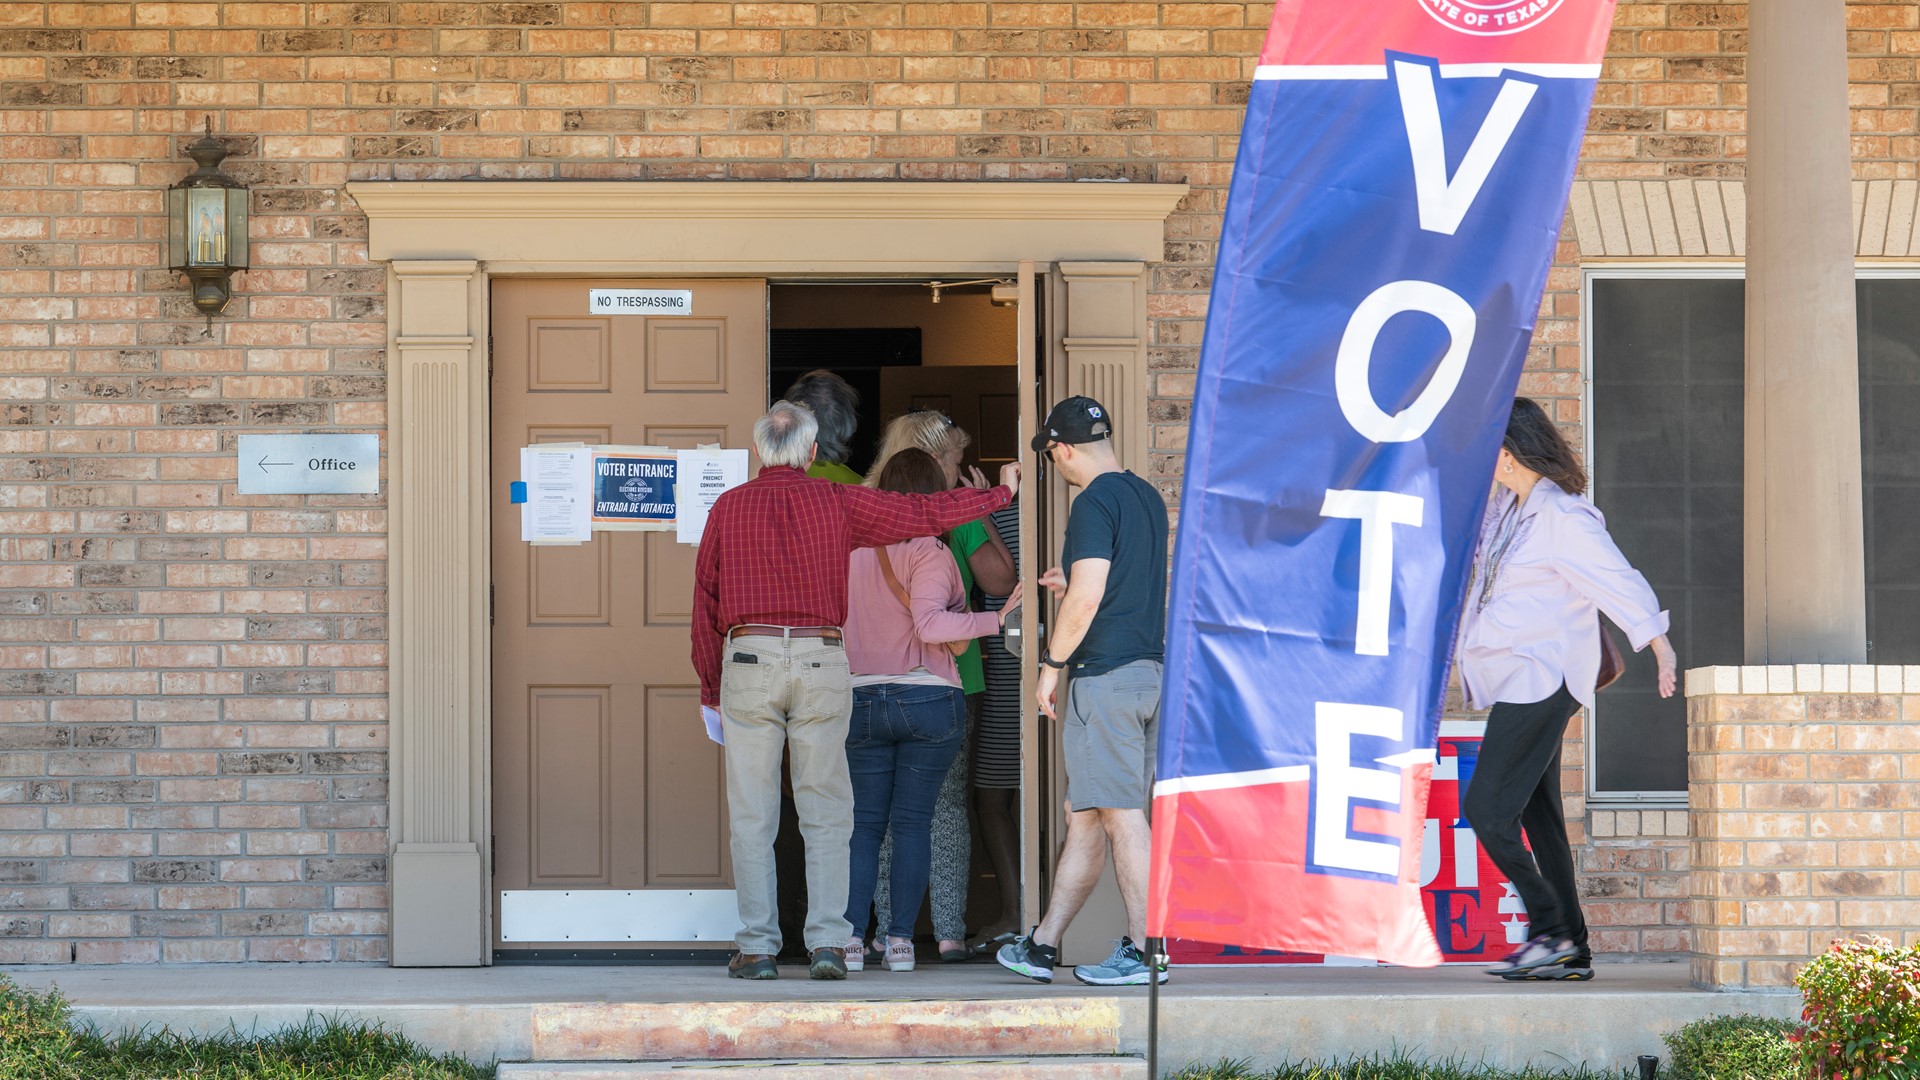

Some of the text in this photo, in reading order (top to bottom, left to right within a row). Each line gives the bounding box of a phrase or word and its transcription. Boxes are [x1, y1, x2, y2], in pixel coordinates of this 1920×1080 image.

[1463, 12, 1489, 26] OF
[1493, 0, 1549, 26] TEXAS
[597, 296, 684, 307] NO TRESPASSING
[308, 458, 356, 471] Office
[597, 462, 675, 478] VOTER ENTRANCE
[1313, 59, 1538, 876] VOTE
[596, 501, 676, 514] ENTRADA DE VOTANTES
